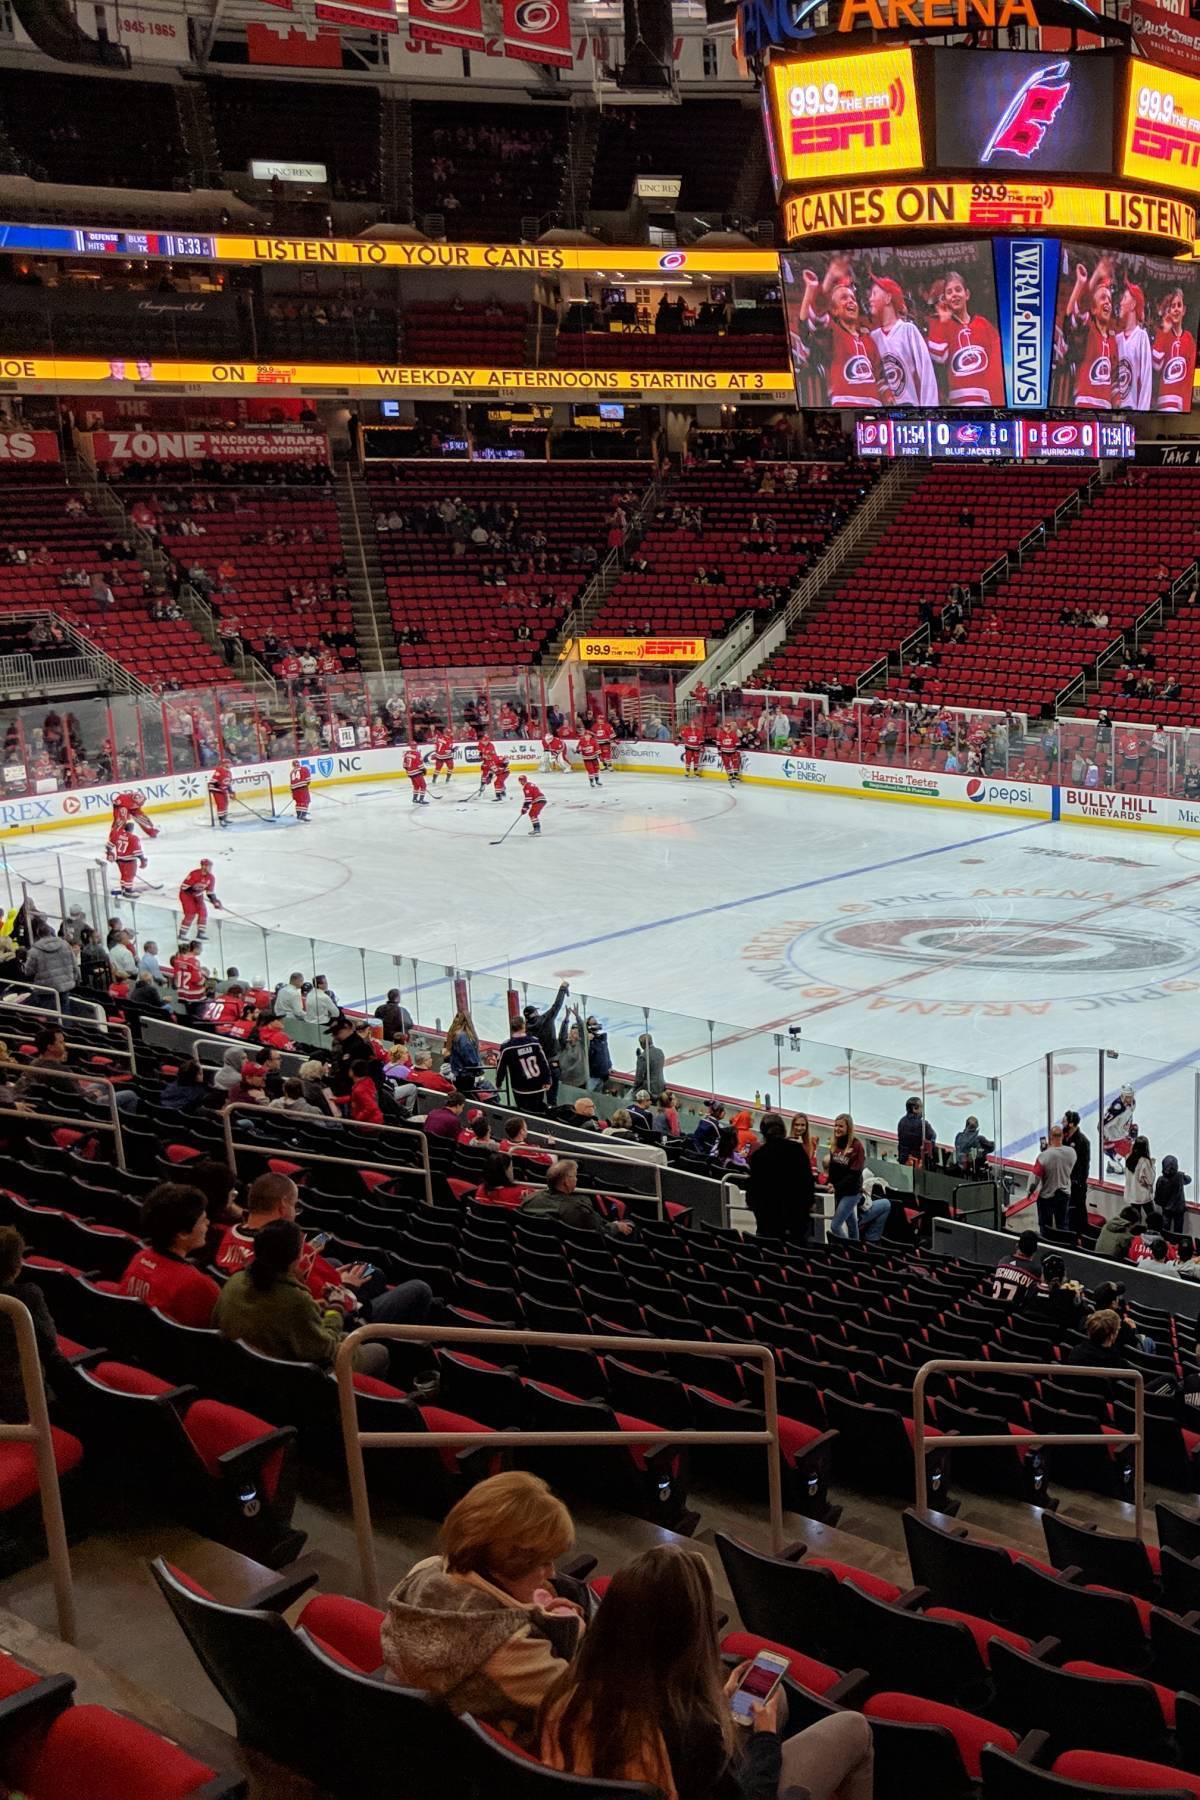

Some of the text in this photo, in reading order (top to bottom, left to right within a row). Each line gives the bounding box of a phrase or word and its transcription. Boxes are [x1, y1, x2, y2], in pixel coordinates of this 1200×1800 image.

[838, 0, 1040, 32] ARENA
[789, 83, 890, 117] 99.9 THE FAN
[1138, 86, 1174, 123] 99.9
[791, 107, 891, 155] ESPN
[639, 183, 681, 194] UNC REX
[801, 184, 1182, 237] CANES ON 99.9 LISTEN
[968, 202, 1043, 227] ESPN
[88, 242, 105, 251] HITS
[177, 238, 201, 255] 6:33
[253, 239, 565, 269] LISTEN TO YOUR CANES
[1013, 245, 1041, 402] WRAL NEWS
[212, 366, 246, 381] ON
[377, 368, 764, 389] WEEKDAY AFTERNOONS STARTING AT 3
[273, 436, 325, 446] WRAPS
[879, 424, 888, 446] 0
[896, 425, 926, 445] 11:54
[937, 423, 950, 445] 0
[1029, 428, 1037, 443] 0
[1082, 424, 1092, 446] 0
[1102, 426, 1121, 446] 11:54
[109, 434, 206, 459] ZONE
[902, 448, 919, 456] FIRST
[945, 448, 1001, 456] BLUE JACKETS
[1041, 449, 1085, 457] HURRICANES
[1162, 446, 1192, 466] TAKE
[586, 640, 697, 656] 99.9 ESPN
[338, 757, 362, 773] NC
[797, 761, 817, 772] DUKE
[797, 771, 827, 783] ENERGY
[871, 771, 938, 788] Harris Teeter
[988, 784, 1033, 804] pepsi
[1066, 790, 1157, 814] BULLY HILL
[1, 800, 54, 824] REX
[1081, 806, 1142, 822] VINEYARDS
[117, 839, 129, 854] 27
[177, 970, 192, 989] 12
[205, 1003, 225, 1020] 20
[519, 1055, 540, 1080] 10
